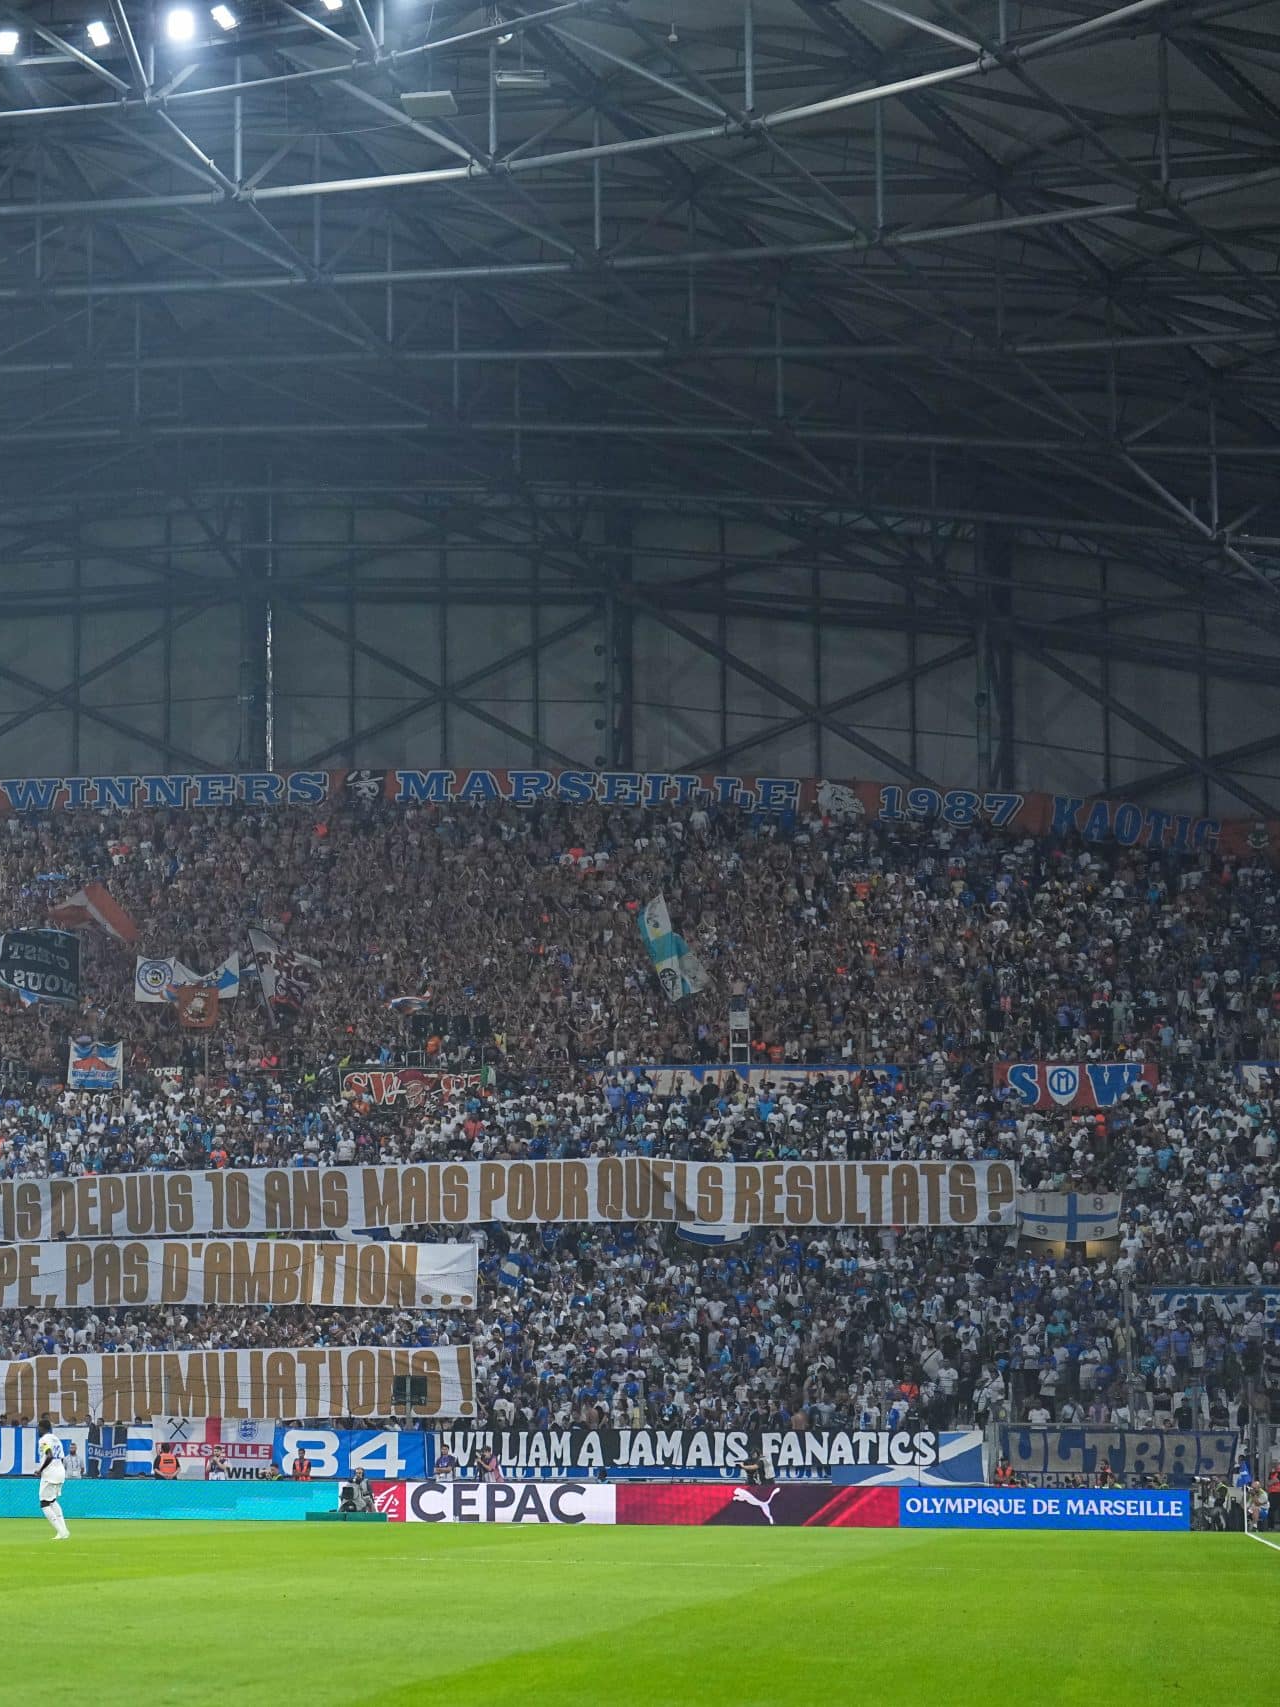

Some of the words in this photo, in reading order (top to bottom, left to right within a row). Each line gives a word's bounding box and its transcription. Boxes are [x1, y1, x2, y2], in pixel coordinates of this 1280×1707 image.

[1, 771, 329, 811] WINNERS
[395, 770, 803, 813] MARSEILLE
[878, 785, 1025, 826] 1987
[50, 1174, 193, 1238] DEPUIS
[205, 1172, 250, 1229] 10
[264, 1170, 349, 1229] ANS
[362, 1163, 470, 1227] MAIS
[480, 1161, 589, 1220] POUR
[596, 1158, 722, 1222] QUELS
[71, 1242, 150, 1304] PAS
[3, 1355, 89, 1425] DES
[157, 1443, 270, 1458] ARSEILLE
[282, 1431, 406, 1478] 84
[577, 1431, 605, 1467] A
[613, 1431, 749, 1467] JAMAIS
[762, 1431, 939, 1467] FANATICS
[1008, 1432, 1234, 1473] ULTRAS
[411, 1484, 587, 1524] CEPAC
[906, 1498, 1025, 1517] OLYMPIQUE
[1032, 1499, 1060, 1515] DE
[1066, 1499, 1183, 1517] MARSEILLE
